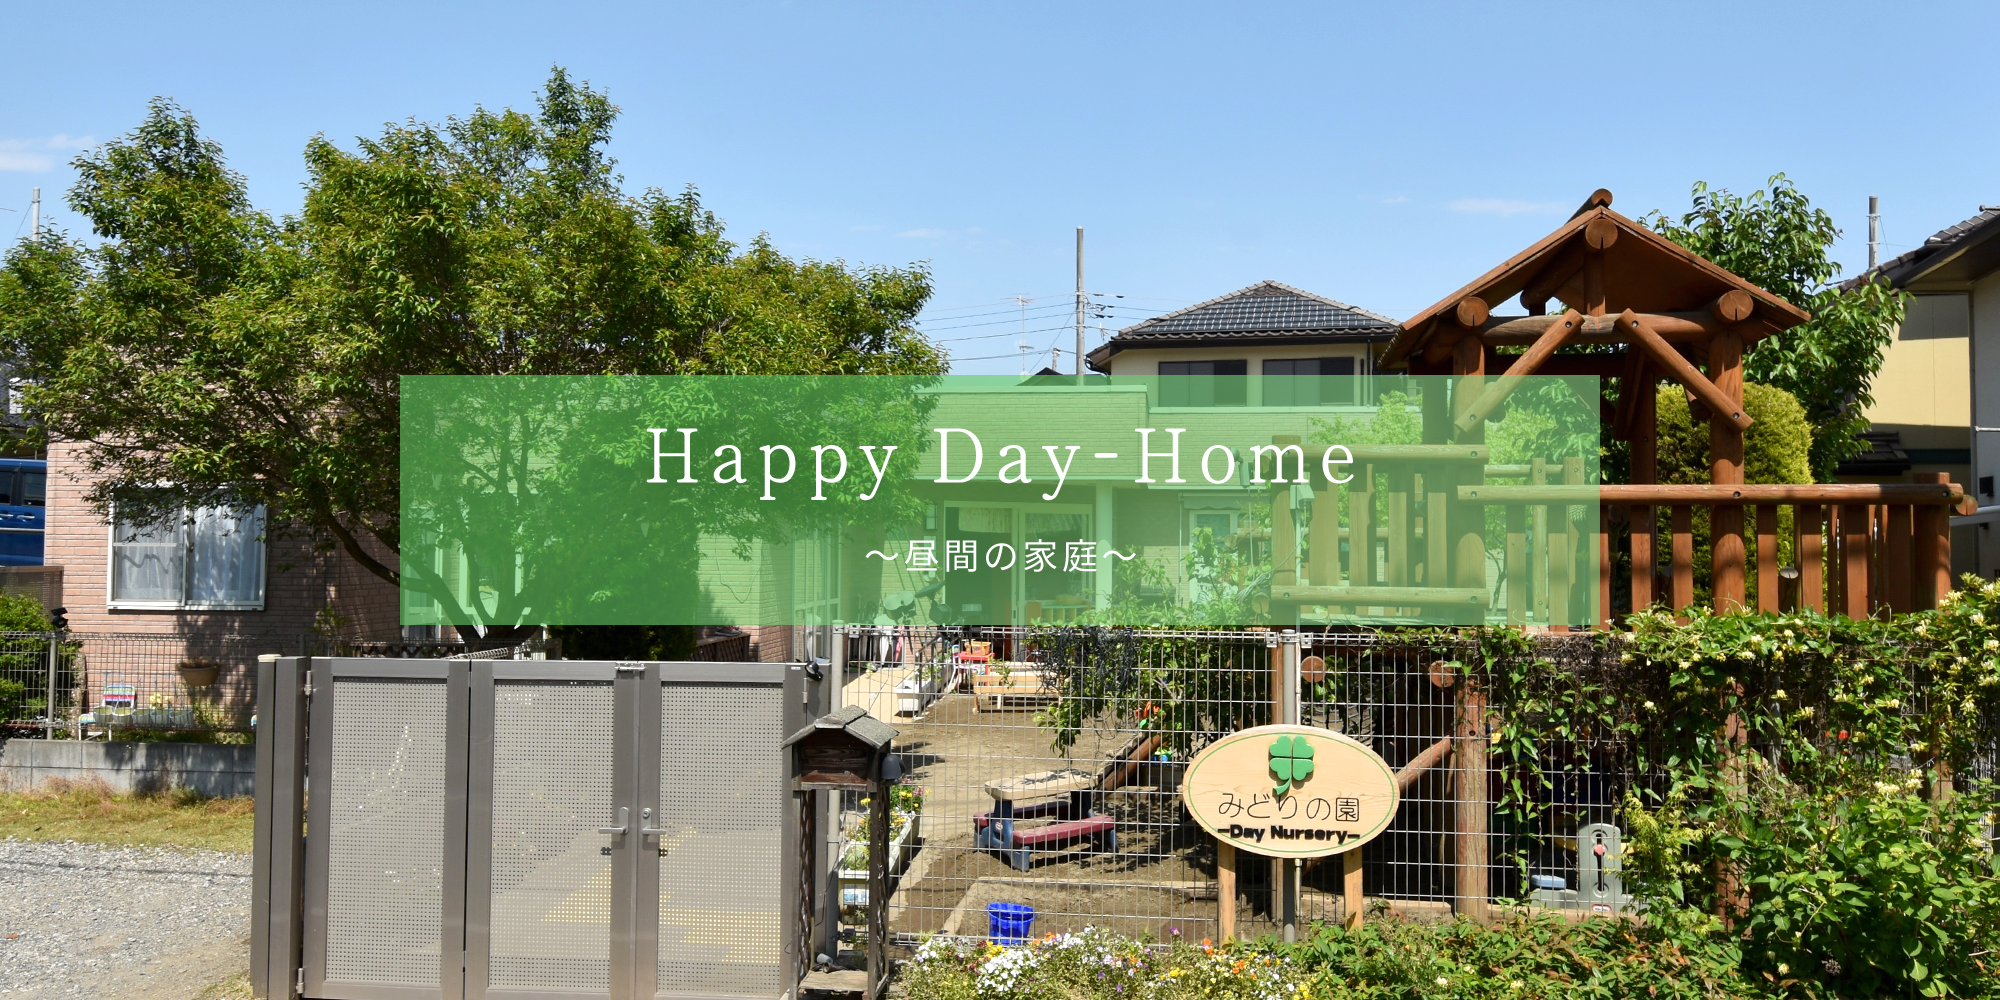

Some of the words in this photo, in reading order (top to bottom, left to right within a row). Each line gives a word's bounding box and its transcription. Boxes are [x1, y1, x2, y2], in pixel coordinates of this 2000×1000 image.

[1218, 792, 1360, 822] みどりの園
